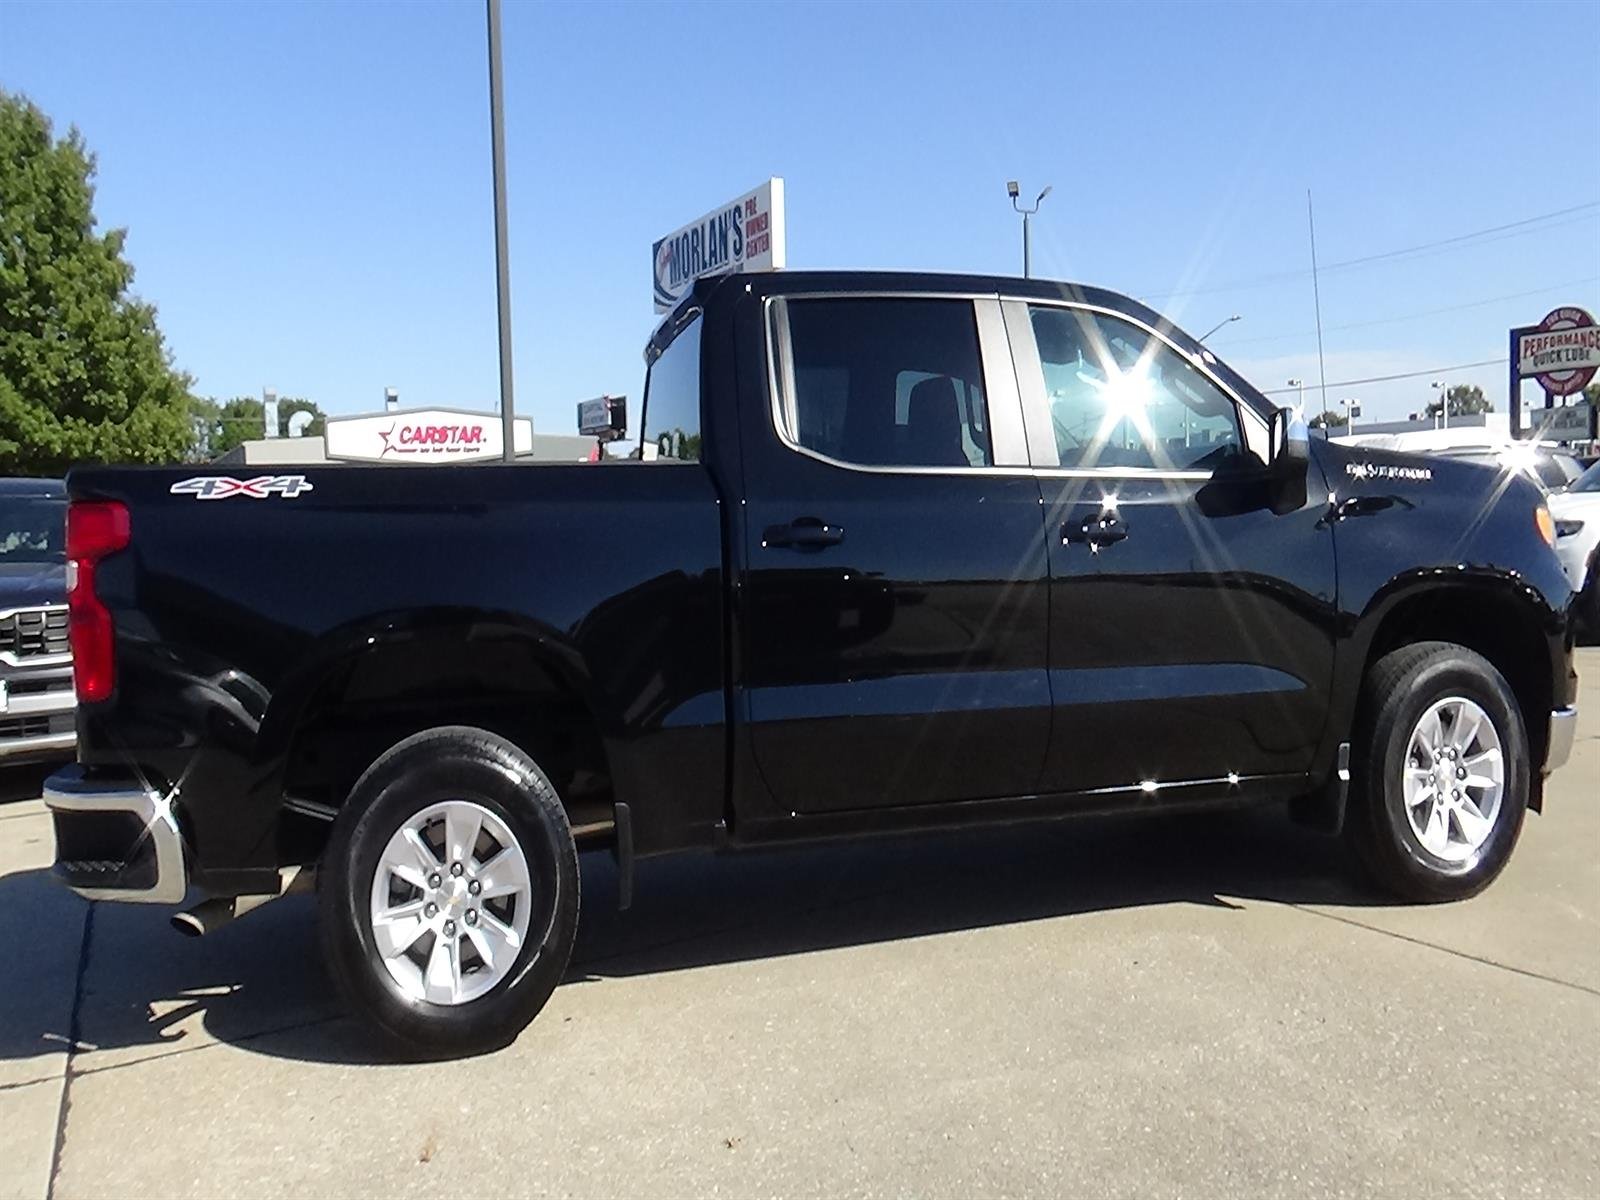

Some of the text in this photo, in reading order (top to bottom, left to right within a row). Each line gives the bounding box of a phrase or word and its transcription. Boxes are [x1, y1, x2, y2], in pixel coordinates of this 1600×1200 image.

[669, 205, 743, 285] MORLAN'S
[1523, 331, 1600, 358] PERFORMANCE
[1533, 347, 1592, 367] QUICK LUBE
